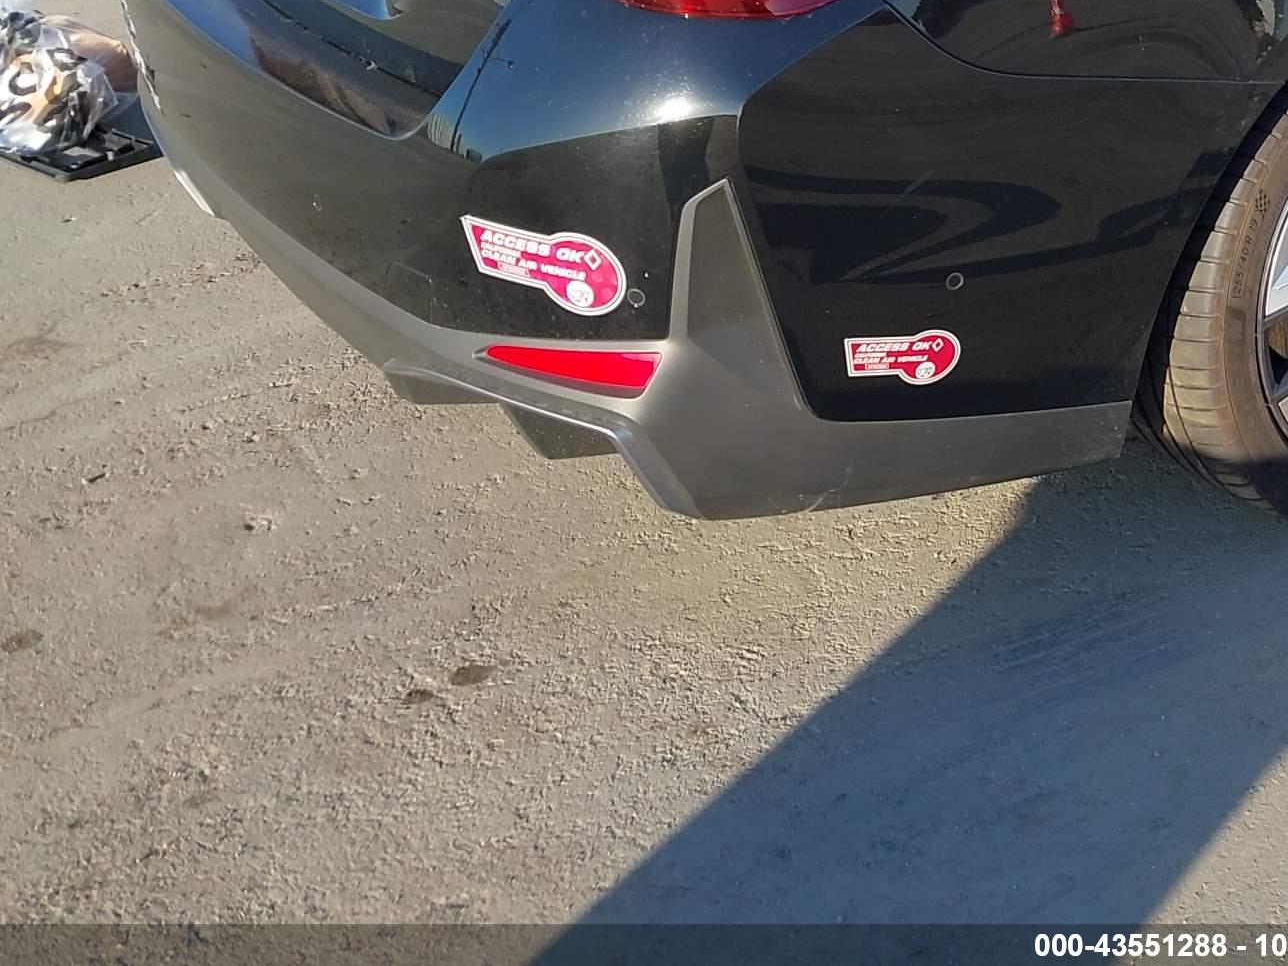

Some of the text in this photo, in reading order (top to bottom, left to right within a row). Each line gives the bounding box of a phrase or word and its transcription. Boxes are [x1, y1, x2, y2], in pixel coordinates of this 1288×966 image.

[480, 229, 585, 263] ACCESS OK
[481, 249, 517, 265] CLEAN
[540, 263, 587, 281] VEHICLE
[856, 342, 932, 352] ACCESS OK
[898, 355, 928, 363] VEHICLE
